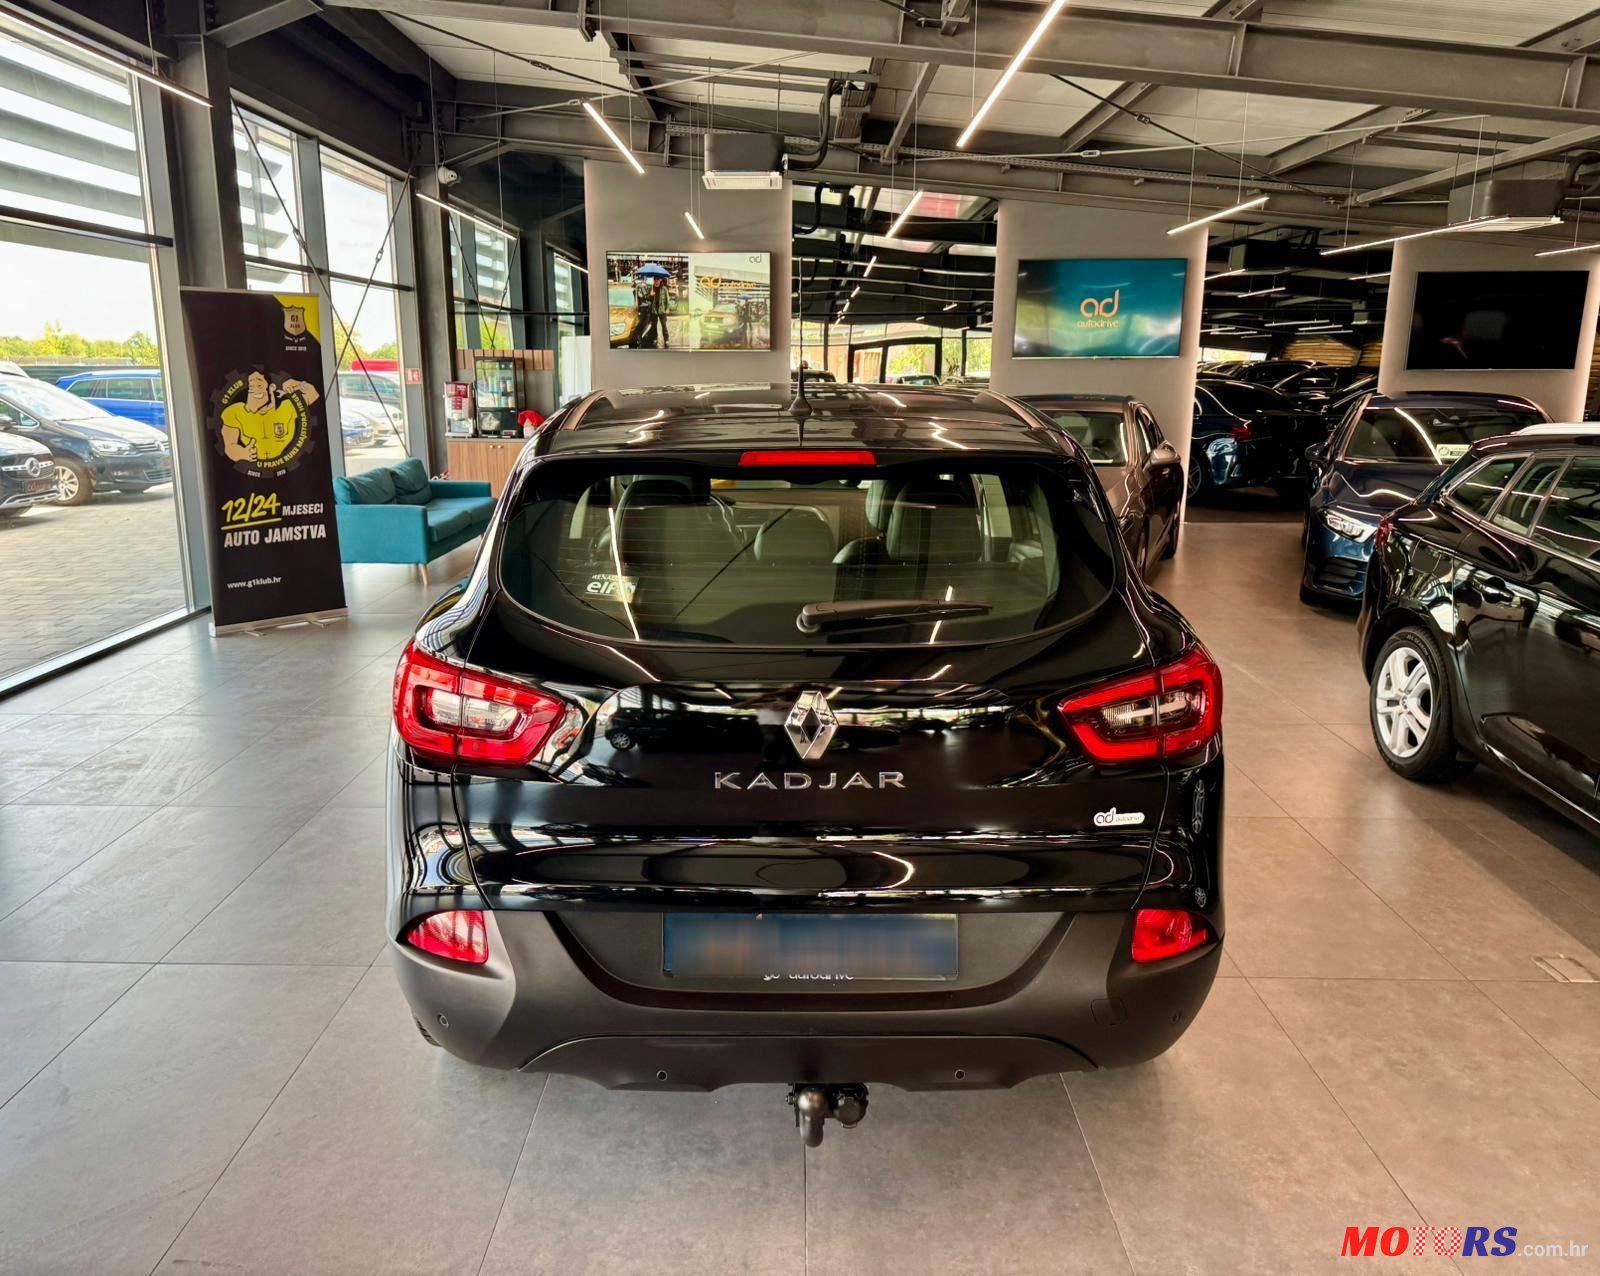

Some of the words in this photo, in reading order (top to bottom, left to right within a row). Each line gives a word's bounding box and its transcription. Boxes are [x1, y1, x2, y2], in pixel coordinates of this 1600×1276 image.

[1076, 320, 1120, 328] autodrive
[222, 393, 231, 405] G1
[227, 380, 244, 395] KLUB
[263, 459, 285, 468] PRAVE
[284, 446, 299, 461] RUKE
[295, 411, 308, 448] MAJSTORA
[221, 492, 281, 522] 12/24
[282, 503, 324, 517] MJESECI
[224, 529, 260, 548] AUTO
[264, 524, 327, 544] JAMSTVA
[227, 576, 282, 589] www.g1klub.hr
[714, 771, 906, 790] KADJAR
